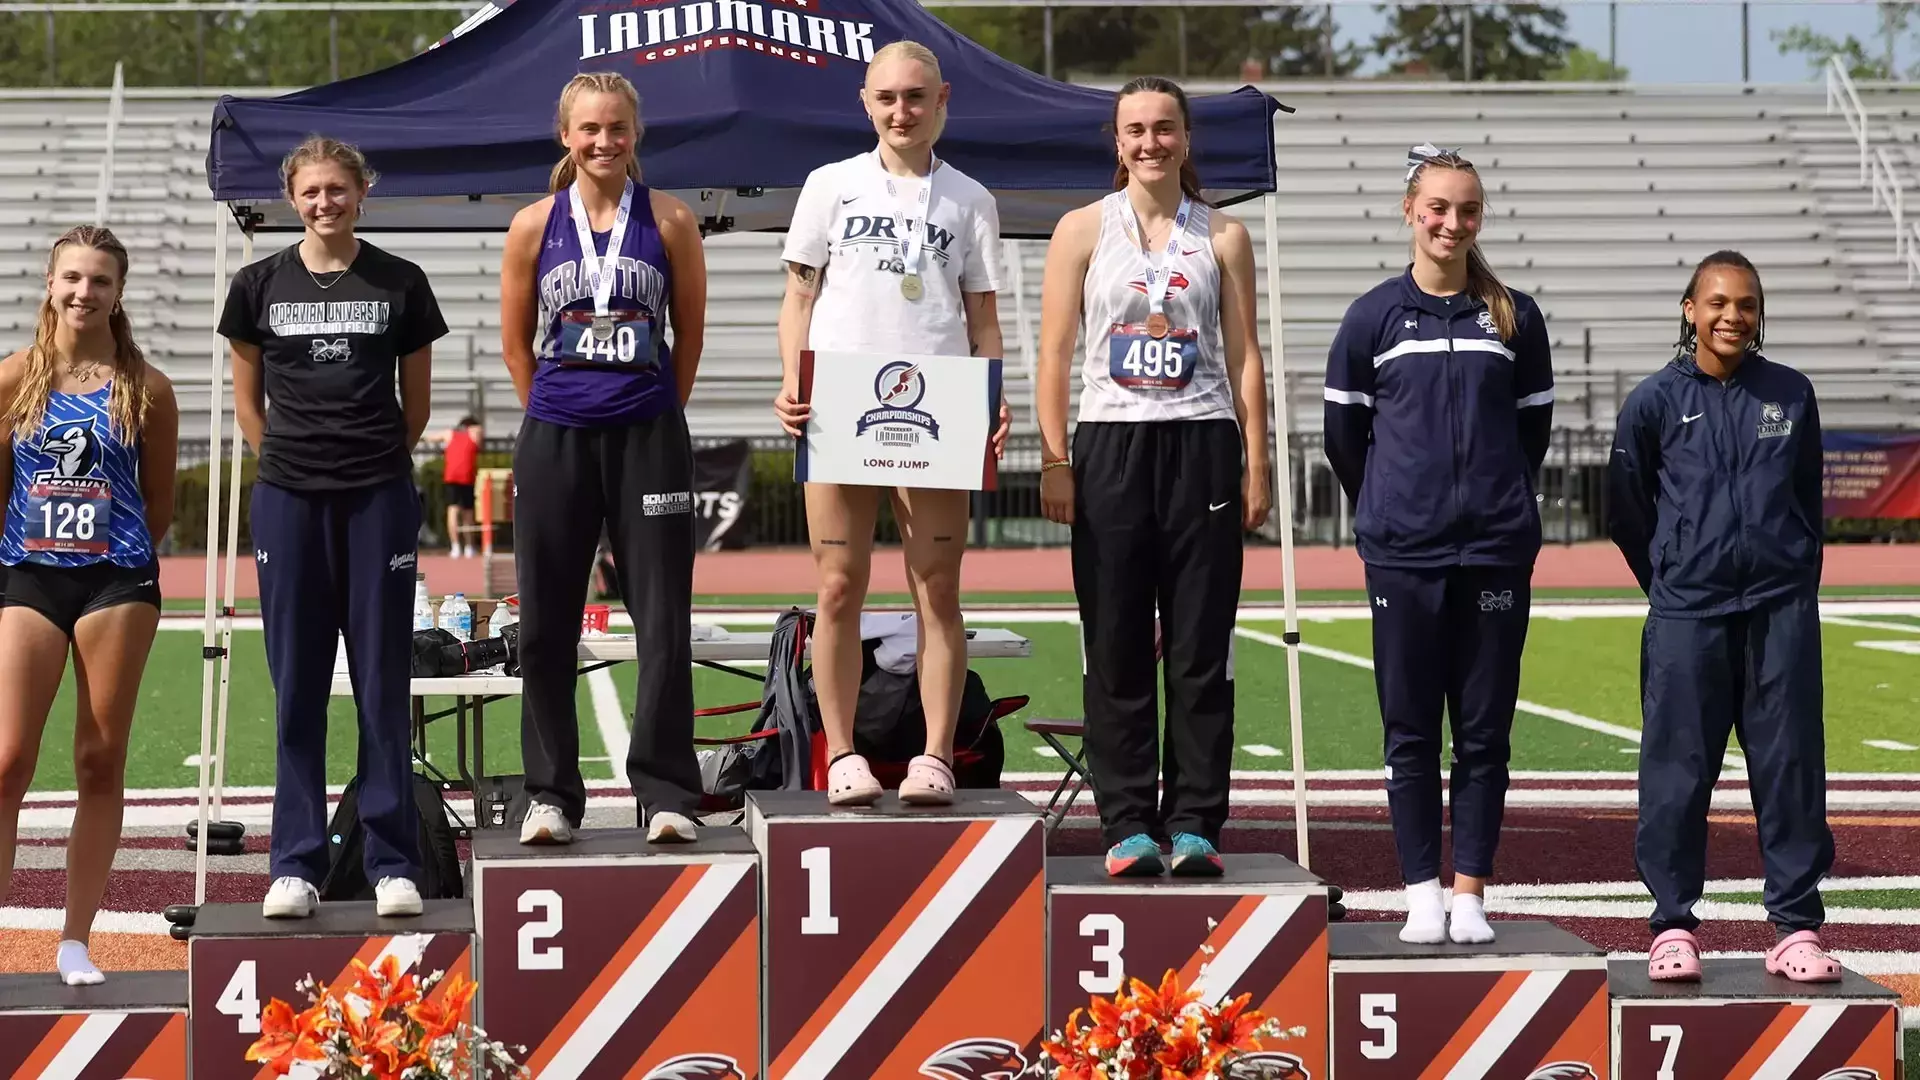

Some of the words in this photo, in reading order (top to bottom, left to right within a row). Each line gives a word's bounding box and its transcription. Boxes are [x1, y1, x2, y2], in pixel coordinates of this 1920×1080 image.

[578, 0, 875, 64] LANDMARK
[645, 36, 817, 65] CONFERENCE
[842, 215, 956, 251] DRW
[269, 302, 326, 327] MORAVIAN
[326, 301, 390, 325] UNIVERSITY
[284, 322, 318, 336] TRACK
[320, 321, 342, 334] AND
[345, 321, 377, 334] FIELD
[575, 326, 636, 363] 440
[1122, 339, 1183, 379] 495
[865, 410, 931, 427] CHAMPIONSHIPS
[1759, 421, 1790, 433] DREW
[863, 458, 895, 468] LONG
[897, 460, 930, 469] JUMP
[642, 491, 690, 505] SCRANTON
[40, 501, 96, 540] 128
[801, 847, 839, 934] 1
[517, 889, 564, 970] 2
[1078, 913, 1124, 993] 3
[215, 960, 260, 1034] 4
[1359, 993, 1397, 1059] 5
[1650, 1025, 1684, 1080] 7
